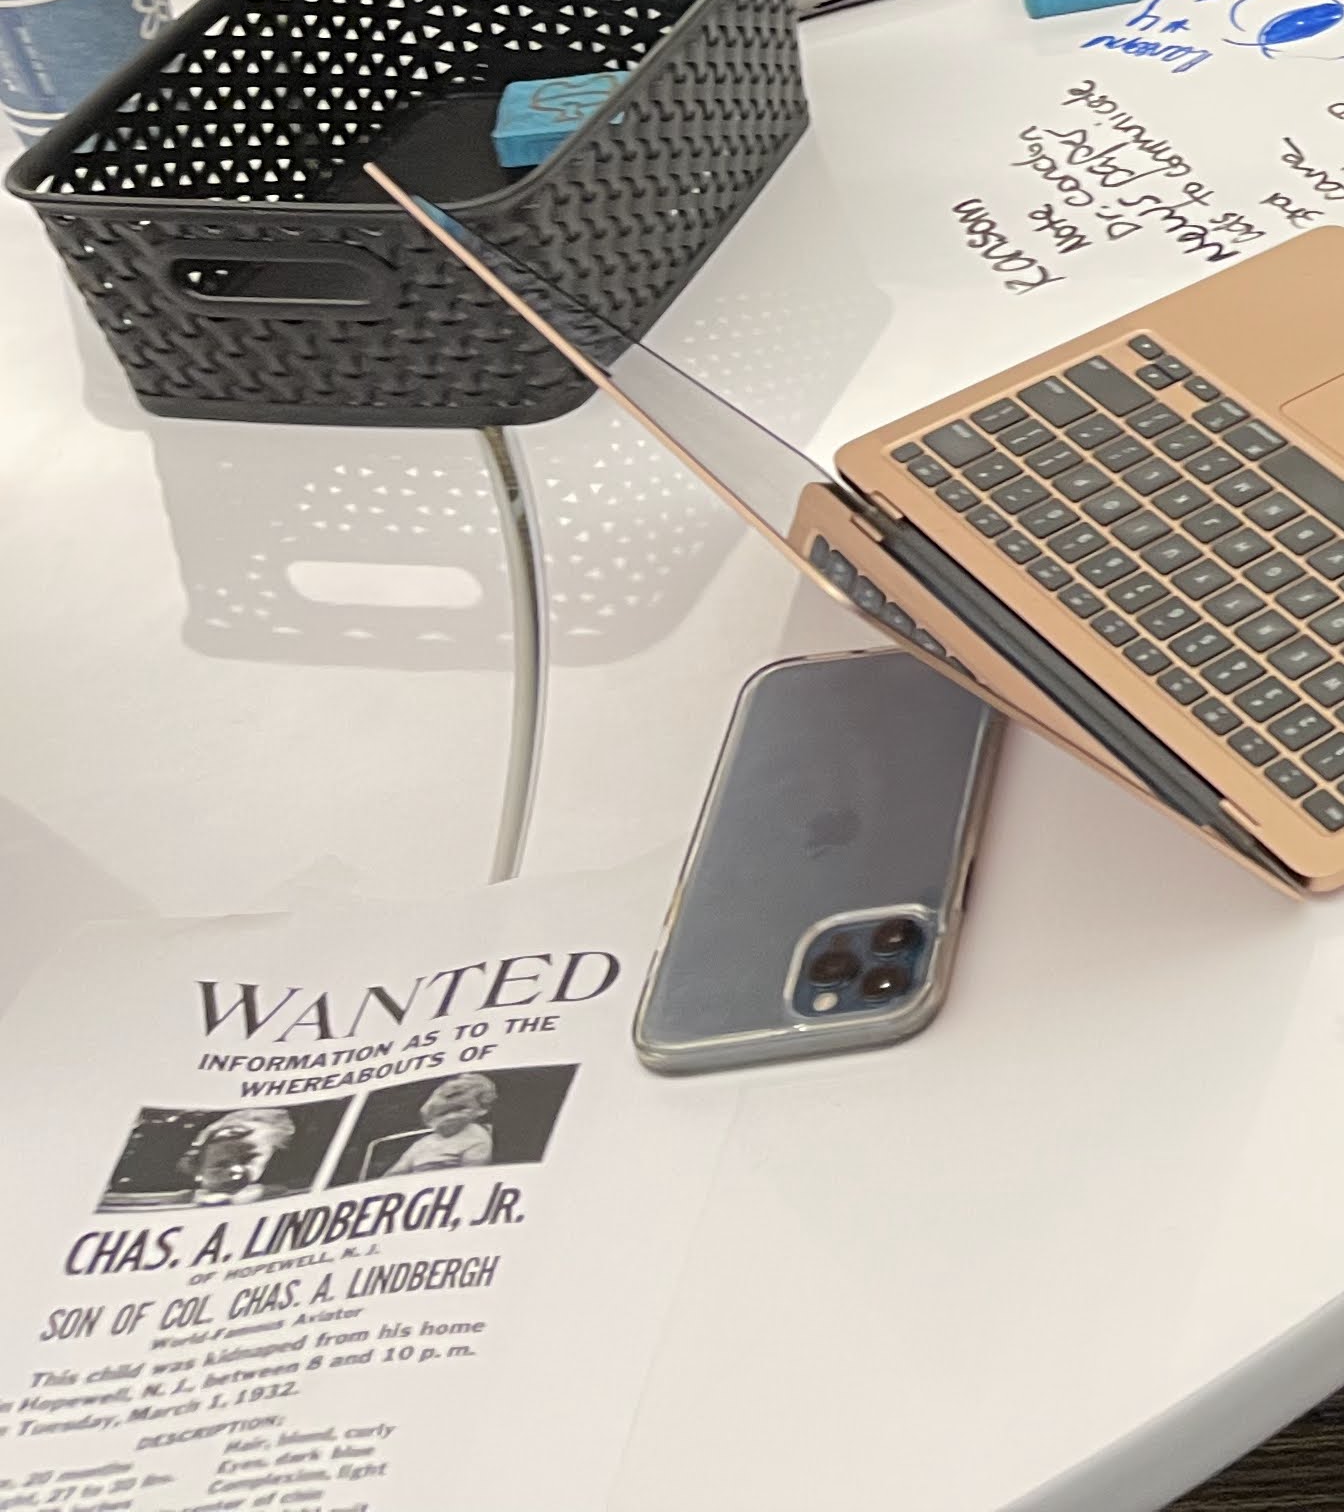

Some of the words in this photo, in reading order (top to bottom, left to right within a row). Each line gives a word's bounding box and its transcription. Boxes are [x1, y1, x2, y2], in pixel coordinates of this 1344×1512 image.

[1182, 182, 1216, 208] to
[1028, 204, 1092, 254] Note
[196, 950, 621, 1044] WANTED
[198, 1040, 394, 1072] INFORMATION
[402, 1030, 441, 1052] AS
[455, 1021, 489, 1041] TO
[504, 1015, 561, 1035] THE
[241, 1052, 444, 1098] WHEREABOUTS
[460, 1044, 498, 1062] OF
[64, 1225, 182, 1275] CHAS.
[194, 1222, 234, 1266] A.
[241, 1182, 466, 1261] LINDBERGH,
[38, 1306, 104, 1342] SON
[110, 1301, 157, 1336] OF
[227, 1282, 301, 1321] CHAS.
[310, 1274, 336, 1303] A.
[346, 1255, 501, 1300] LINDBERGH
[187, 1272, 216, 1287] OF
[292, 1307, 364, 1326] Aviator
[30, 1369, 80, 1389] This
[86, 1361, 144, 1384] child
[152, 1356, 196, 1374] was
[315, 1326, 370, 1348] from
[377, 1320, 412, 1340] his
[420, 1318, 487, 1336] home
[201, 1361, 302, 1388] between
[304, 1355, 325, 1371] 8
[329, 1349, 376, 1369] and
[383, 1345, 414, 1362] 10
[417, 1348, 442, 1364] p.
[447, 1344, 477, 1358] m.
[127, 1400, 202, 1424] March
